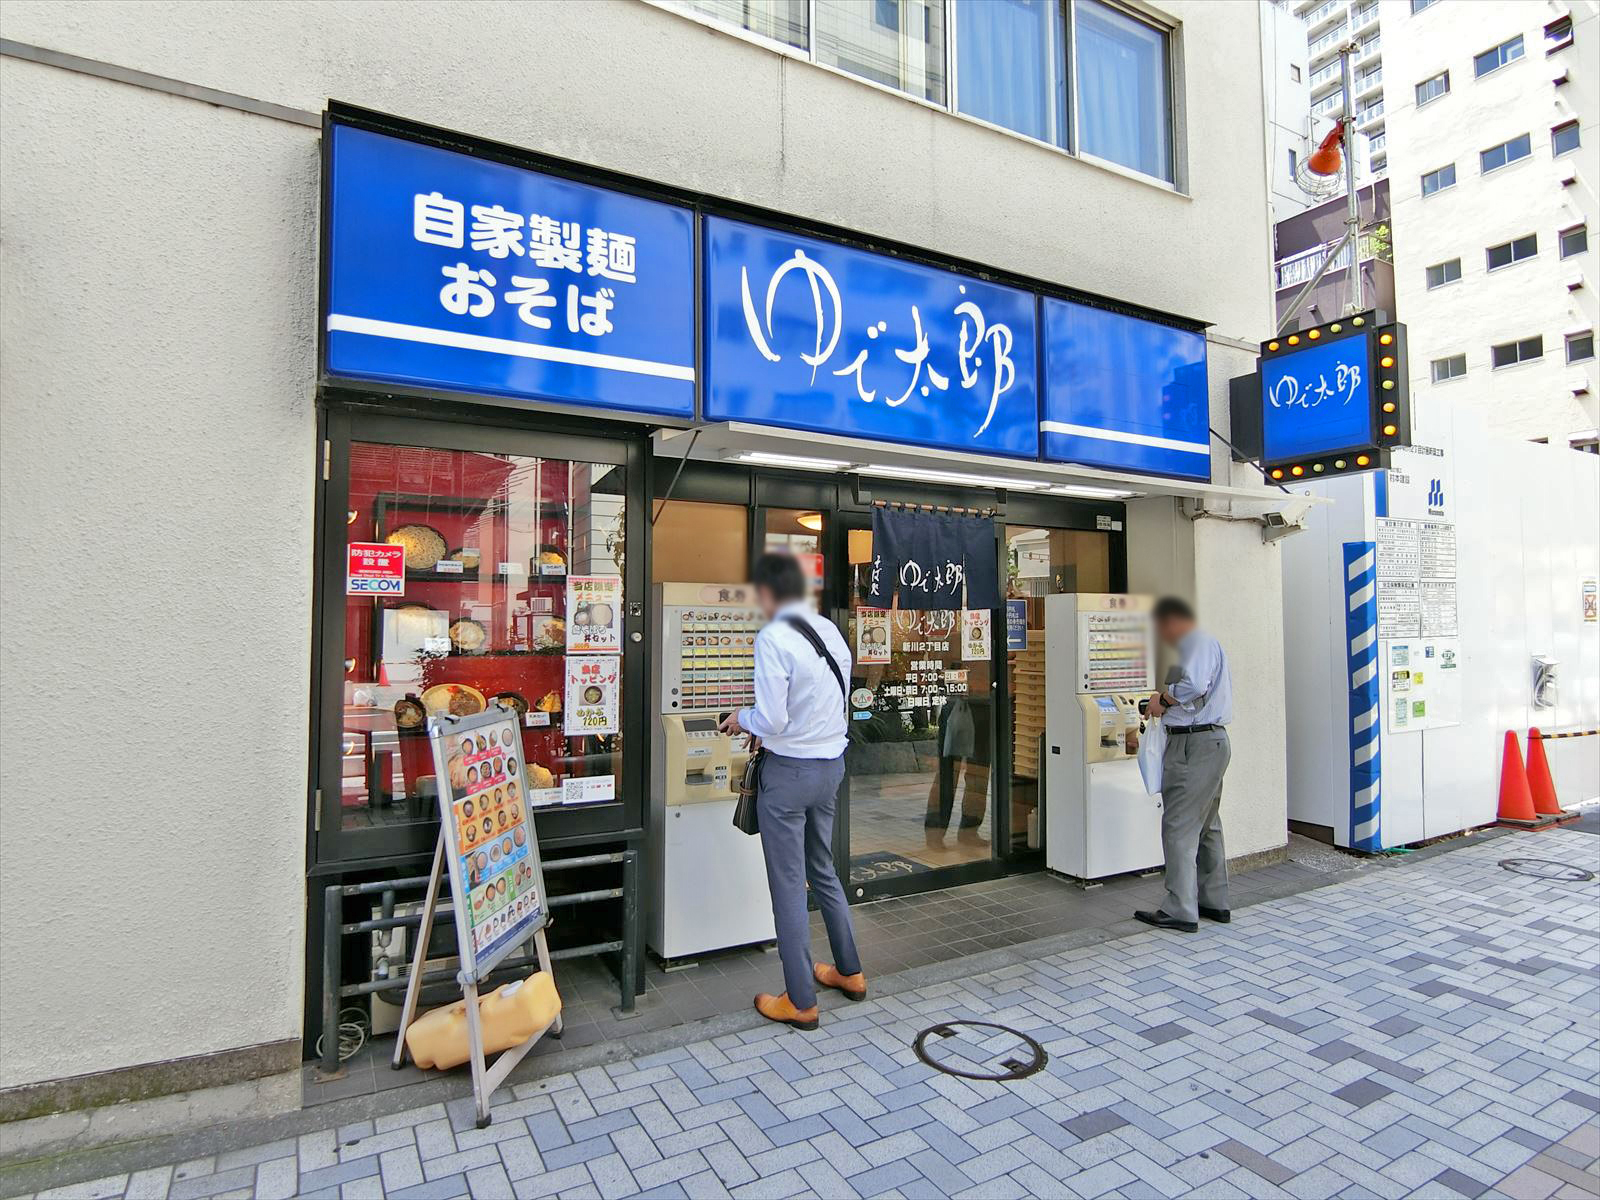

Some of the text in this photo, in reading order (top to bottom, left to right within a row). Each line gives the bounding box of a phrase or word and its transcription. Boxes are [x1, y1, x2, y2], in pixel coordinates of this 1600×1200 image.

[412, 191, 637, 285] 自家製麺
[439, 262, 615, 337] おそば
[740, 249, 1017, 438] ゆで太郎
[1269, 360, 1362, 409] ゆで太郎
[351, 548, 402, 559] 防犯カメラ
[899, 559, 963, 595] ゆで太郎
[351, 579, 401, 591] SECOM
[576, 593, 612, 601] メニュー
[896, 609, 956, 639] ゆで太郎
[902, 641, 950, 653] 新川2丁目店
[910, 660, 943, 671] 営業時間
[570, 674, 617, 685] トッピング
[905, 673, 918, 684] 平日
[907, 696, 930, 707] 日曜日
